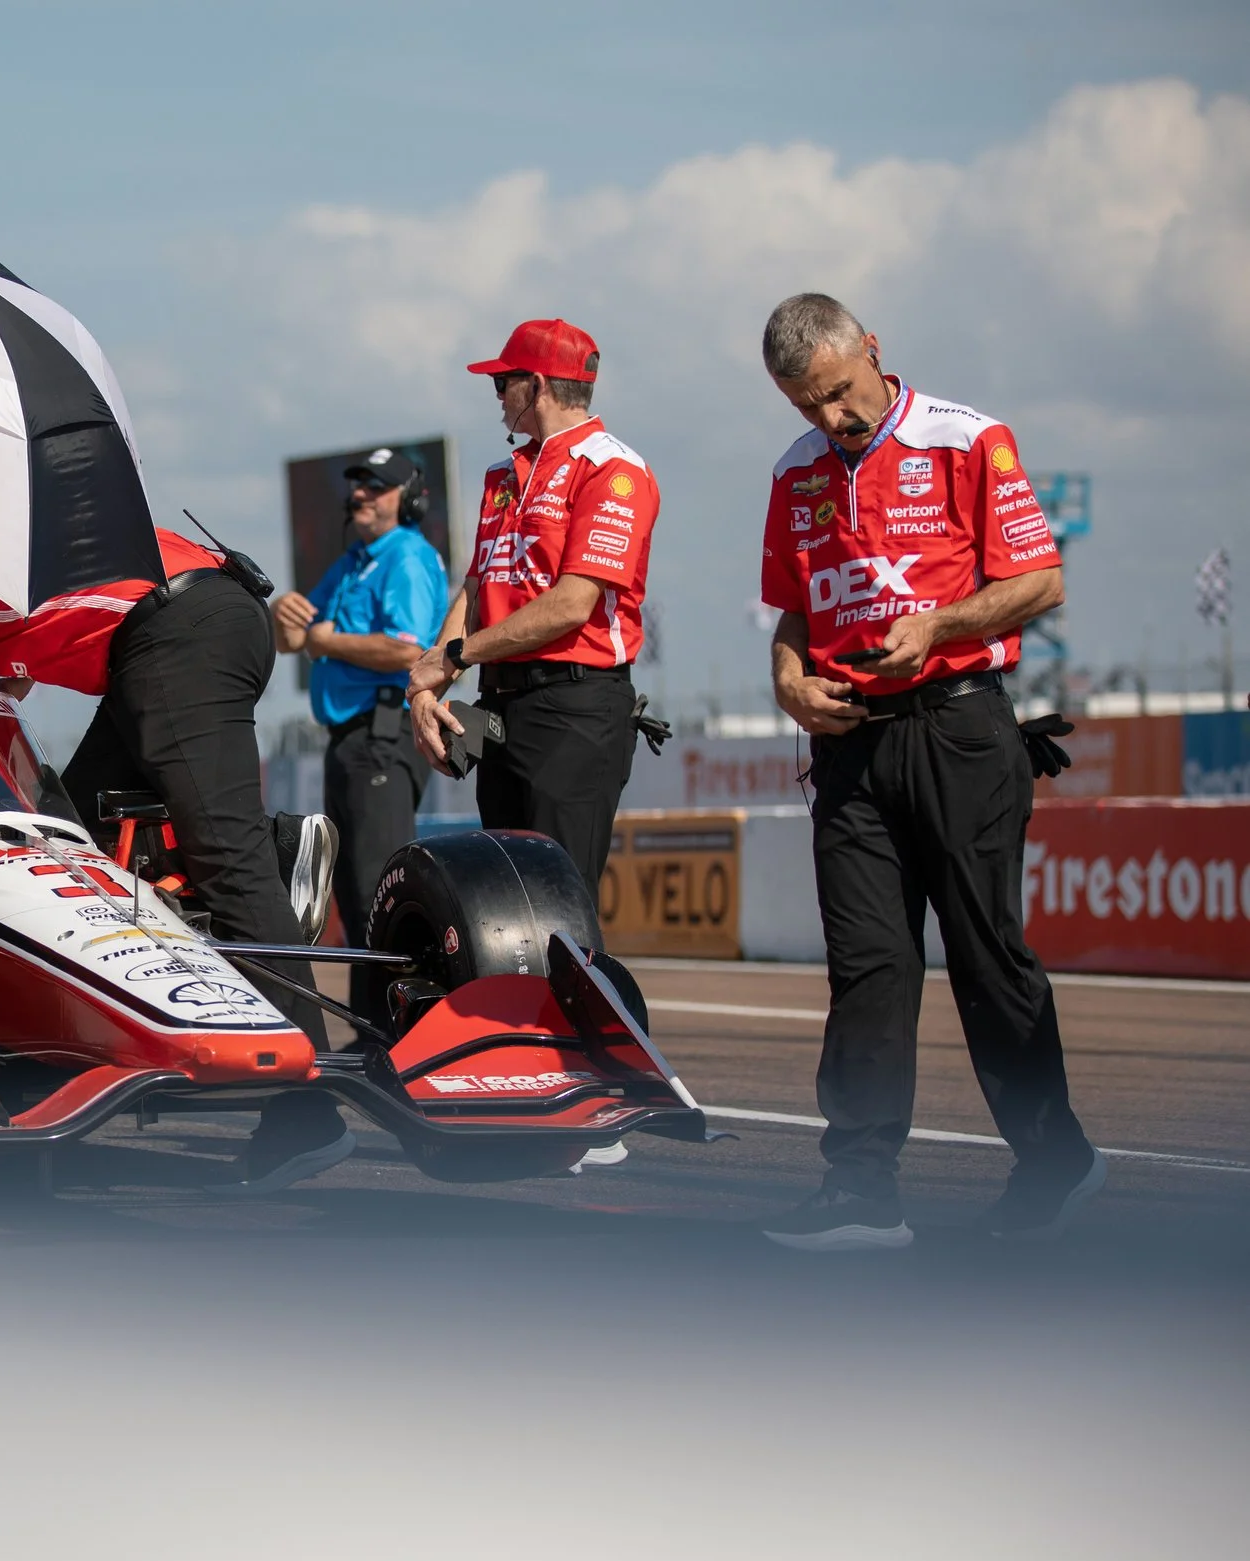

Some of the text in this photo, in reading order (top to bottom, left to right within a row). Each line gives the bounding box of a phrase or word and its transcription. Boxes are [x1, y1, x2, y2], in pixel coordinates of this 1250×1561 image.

[927, 405, 982, 421] Firestone
[898, 472, 933, 481] INDYCAR
[525, 505, 564, 520] HITACHI
[601, 500, 635, 519] XPEL
[886, 504, 938, 518] verizon
[994, 495, 1038, 516] TIRE RAC
[593, 515, 633, 533] TIRE RACK
[886, 521, 945, 535] HITACHI
[1008, 518, 1044, 537] PENSKE
[478, 532, 541, 573] DEX
[582, 553, 625, 570] SIEMENS
[1010, 542, 1057, 563] SIEMENS
[809, 554, 923, 613] DEX
[28, 864, 134, 898] 3
[637, 862, 729, 925] VELO
[365, 867, 405, 948] Firestone
[97, 945, 151, 961] TIRE
[481, 1071, 596, 1085] GOOD
